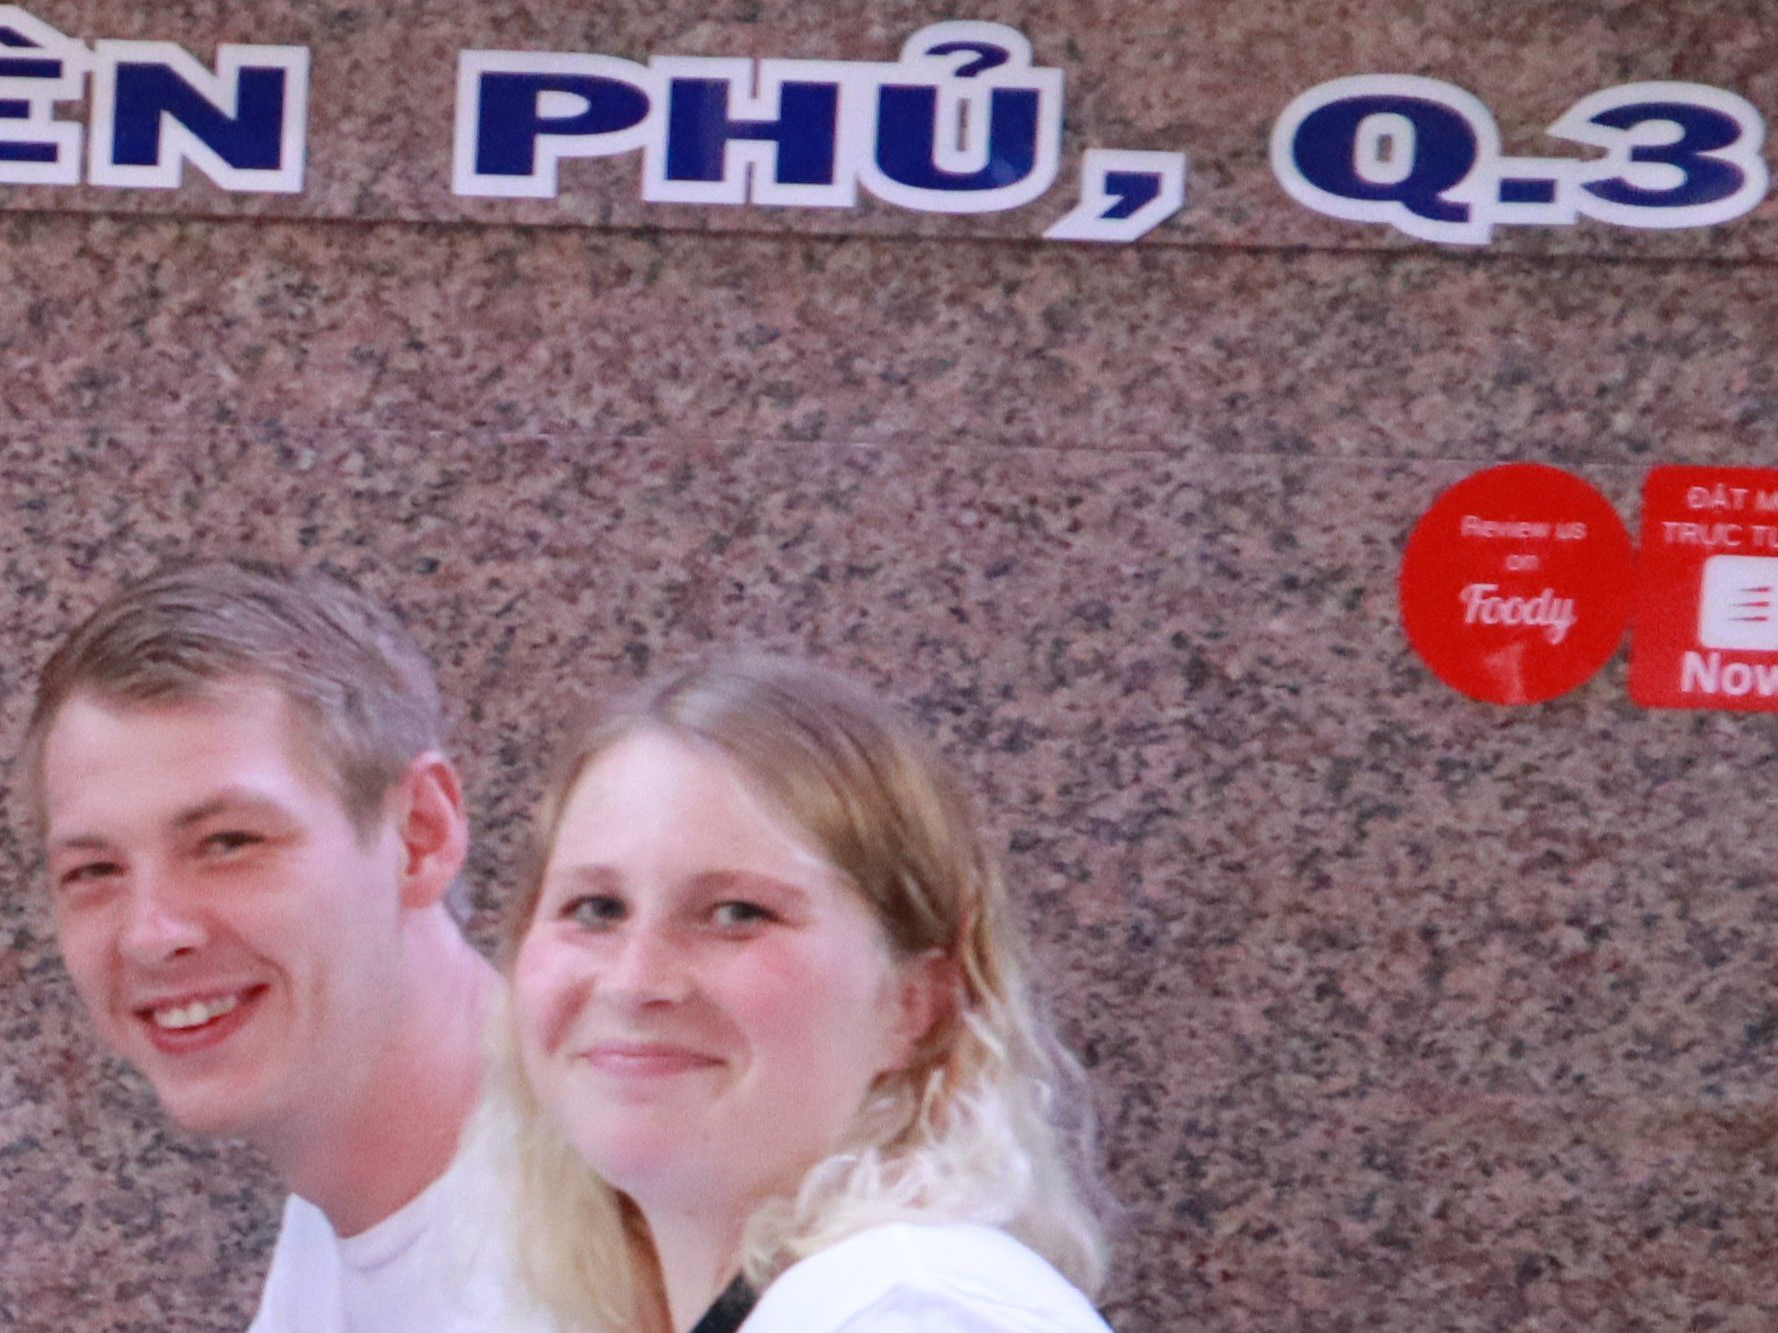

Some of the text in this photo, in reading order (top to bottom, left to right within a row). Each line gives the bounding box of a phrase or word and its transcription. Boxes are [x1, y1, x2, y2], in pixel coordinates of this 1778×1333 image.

[462, 28, 1173, 232] PHỦ,
[1503, 554, 1539, 570] on
[1459, 583, 1577, 644] Foody
